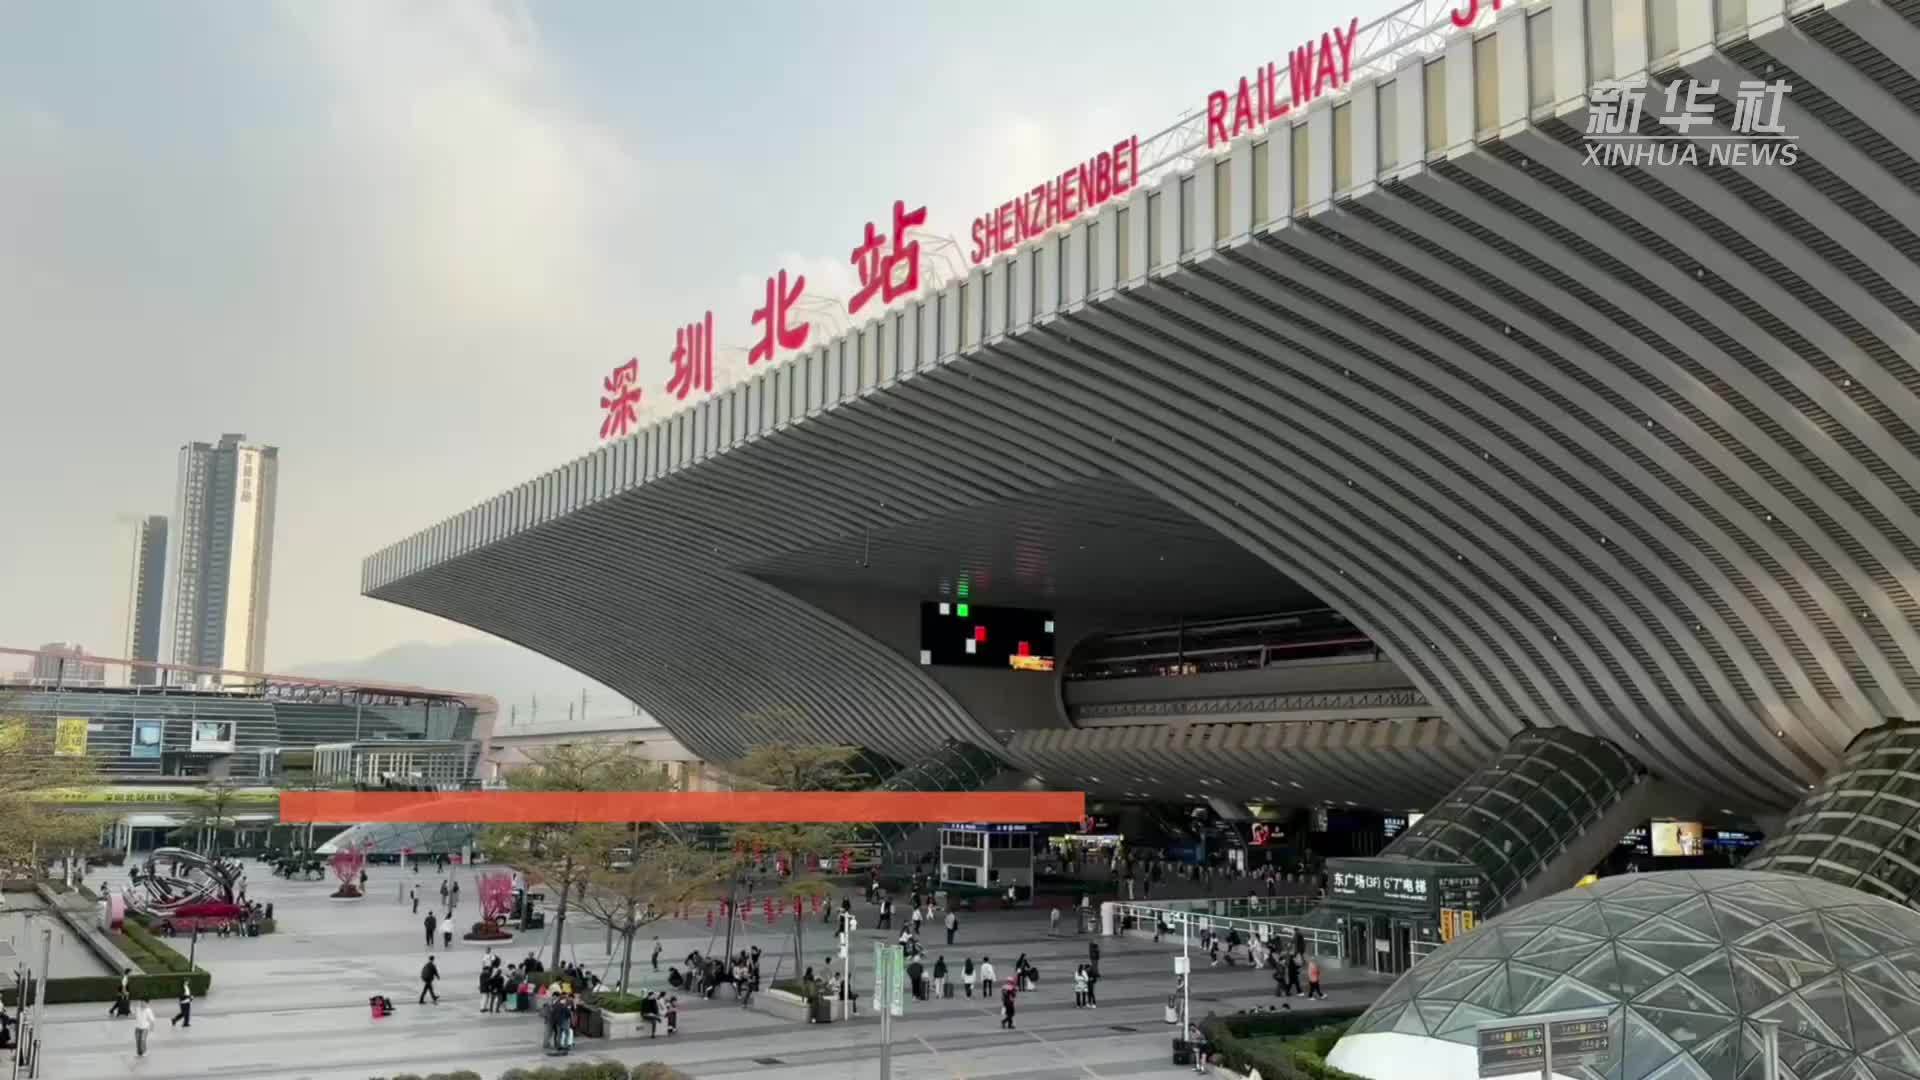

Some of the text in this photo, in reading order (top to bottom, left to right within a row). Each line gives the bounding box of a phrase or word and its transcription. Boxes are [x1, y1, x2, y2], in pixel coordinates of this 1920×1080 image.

[970, 17, 1358, 265] SHENZHENBEI RAILWAY
[600, 200, 928, 439] 深圳北站
